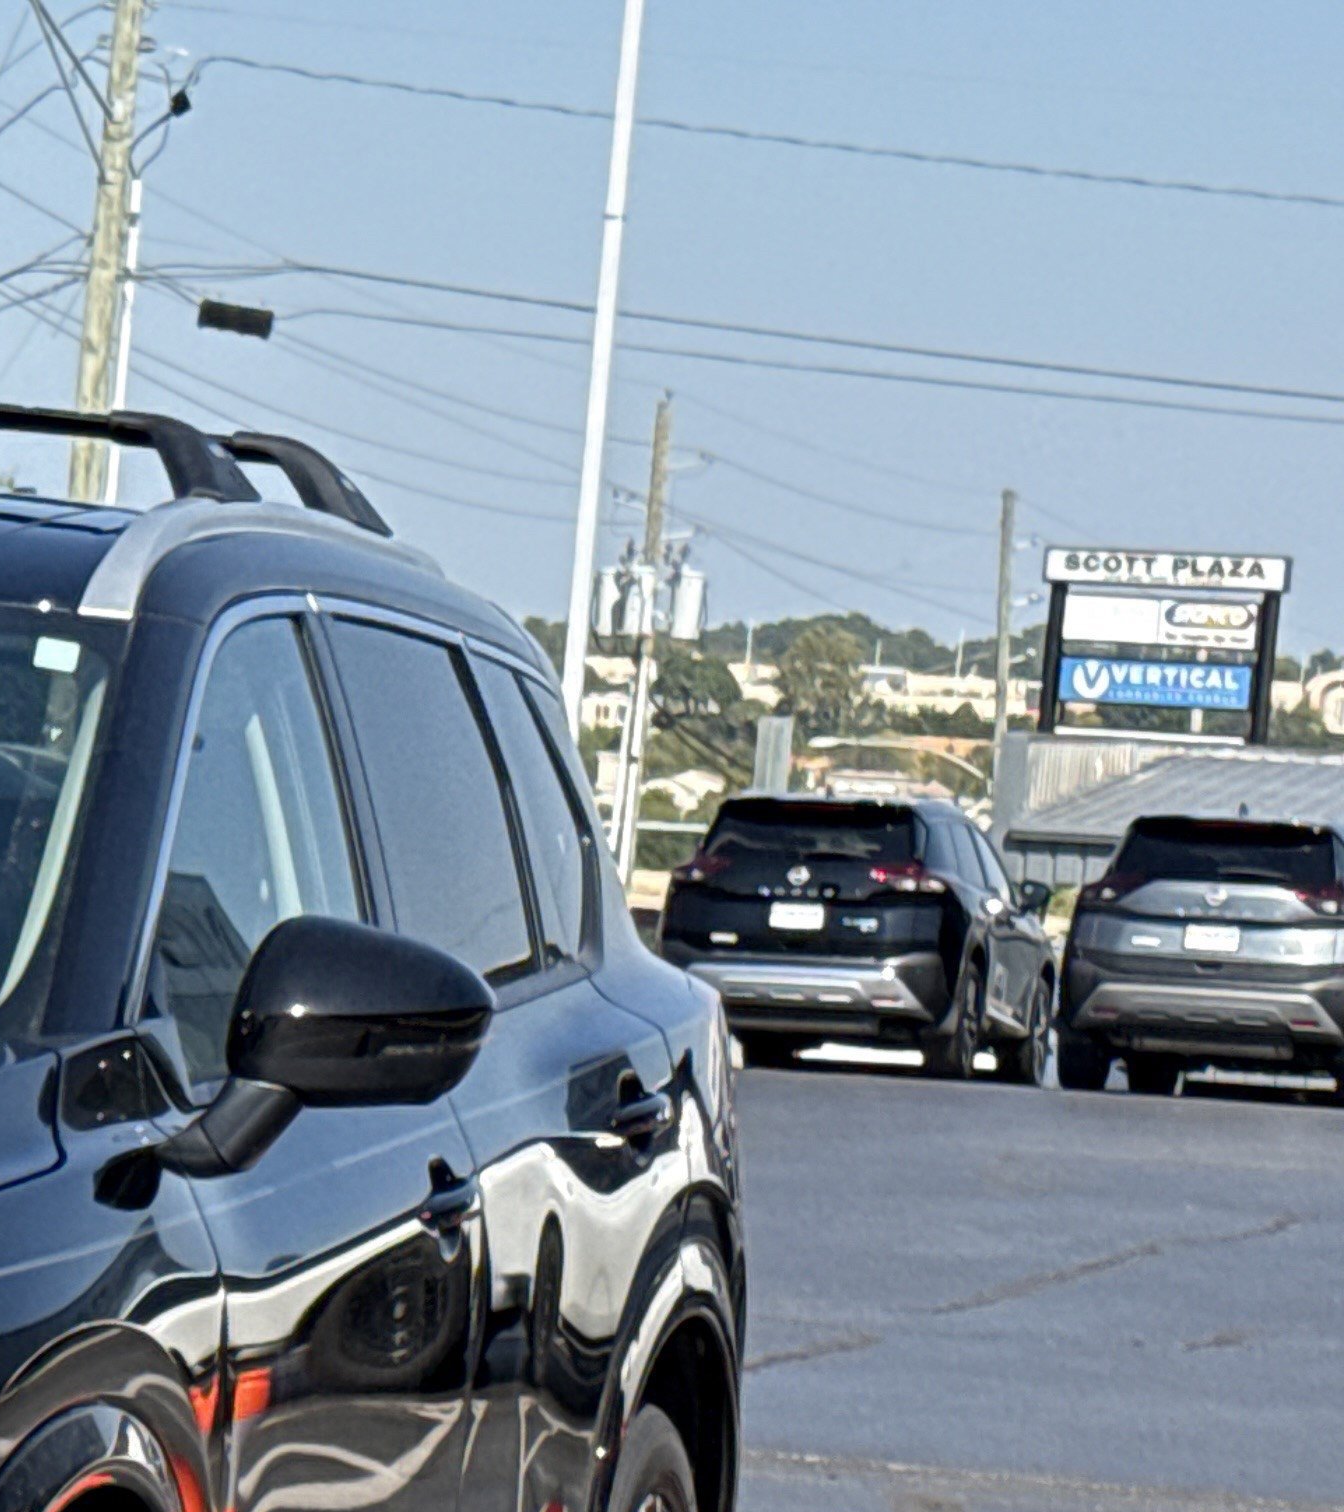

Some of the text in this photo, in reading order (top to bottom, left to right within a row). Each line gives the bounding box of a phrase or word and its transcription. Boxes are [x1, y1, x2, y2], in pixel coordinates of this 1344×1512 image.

[1064, 552, 1156, 576] SCOTT
[1171, 557, 1266, 580] PLAZA
[1111, 663, 1240, 691] VERTICAL
